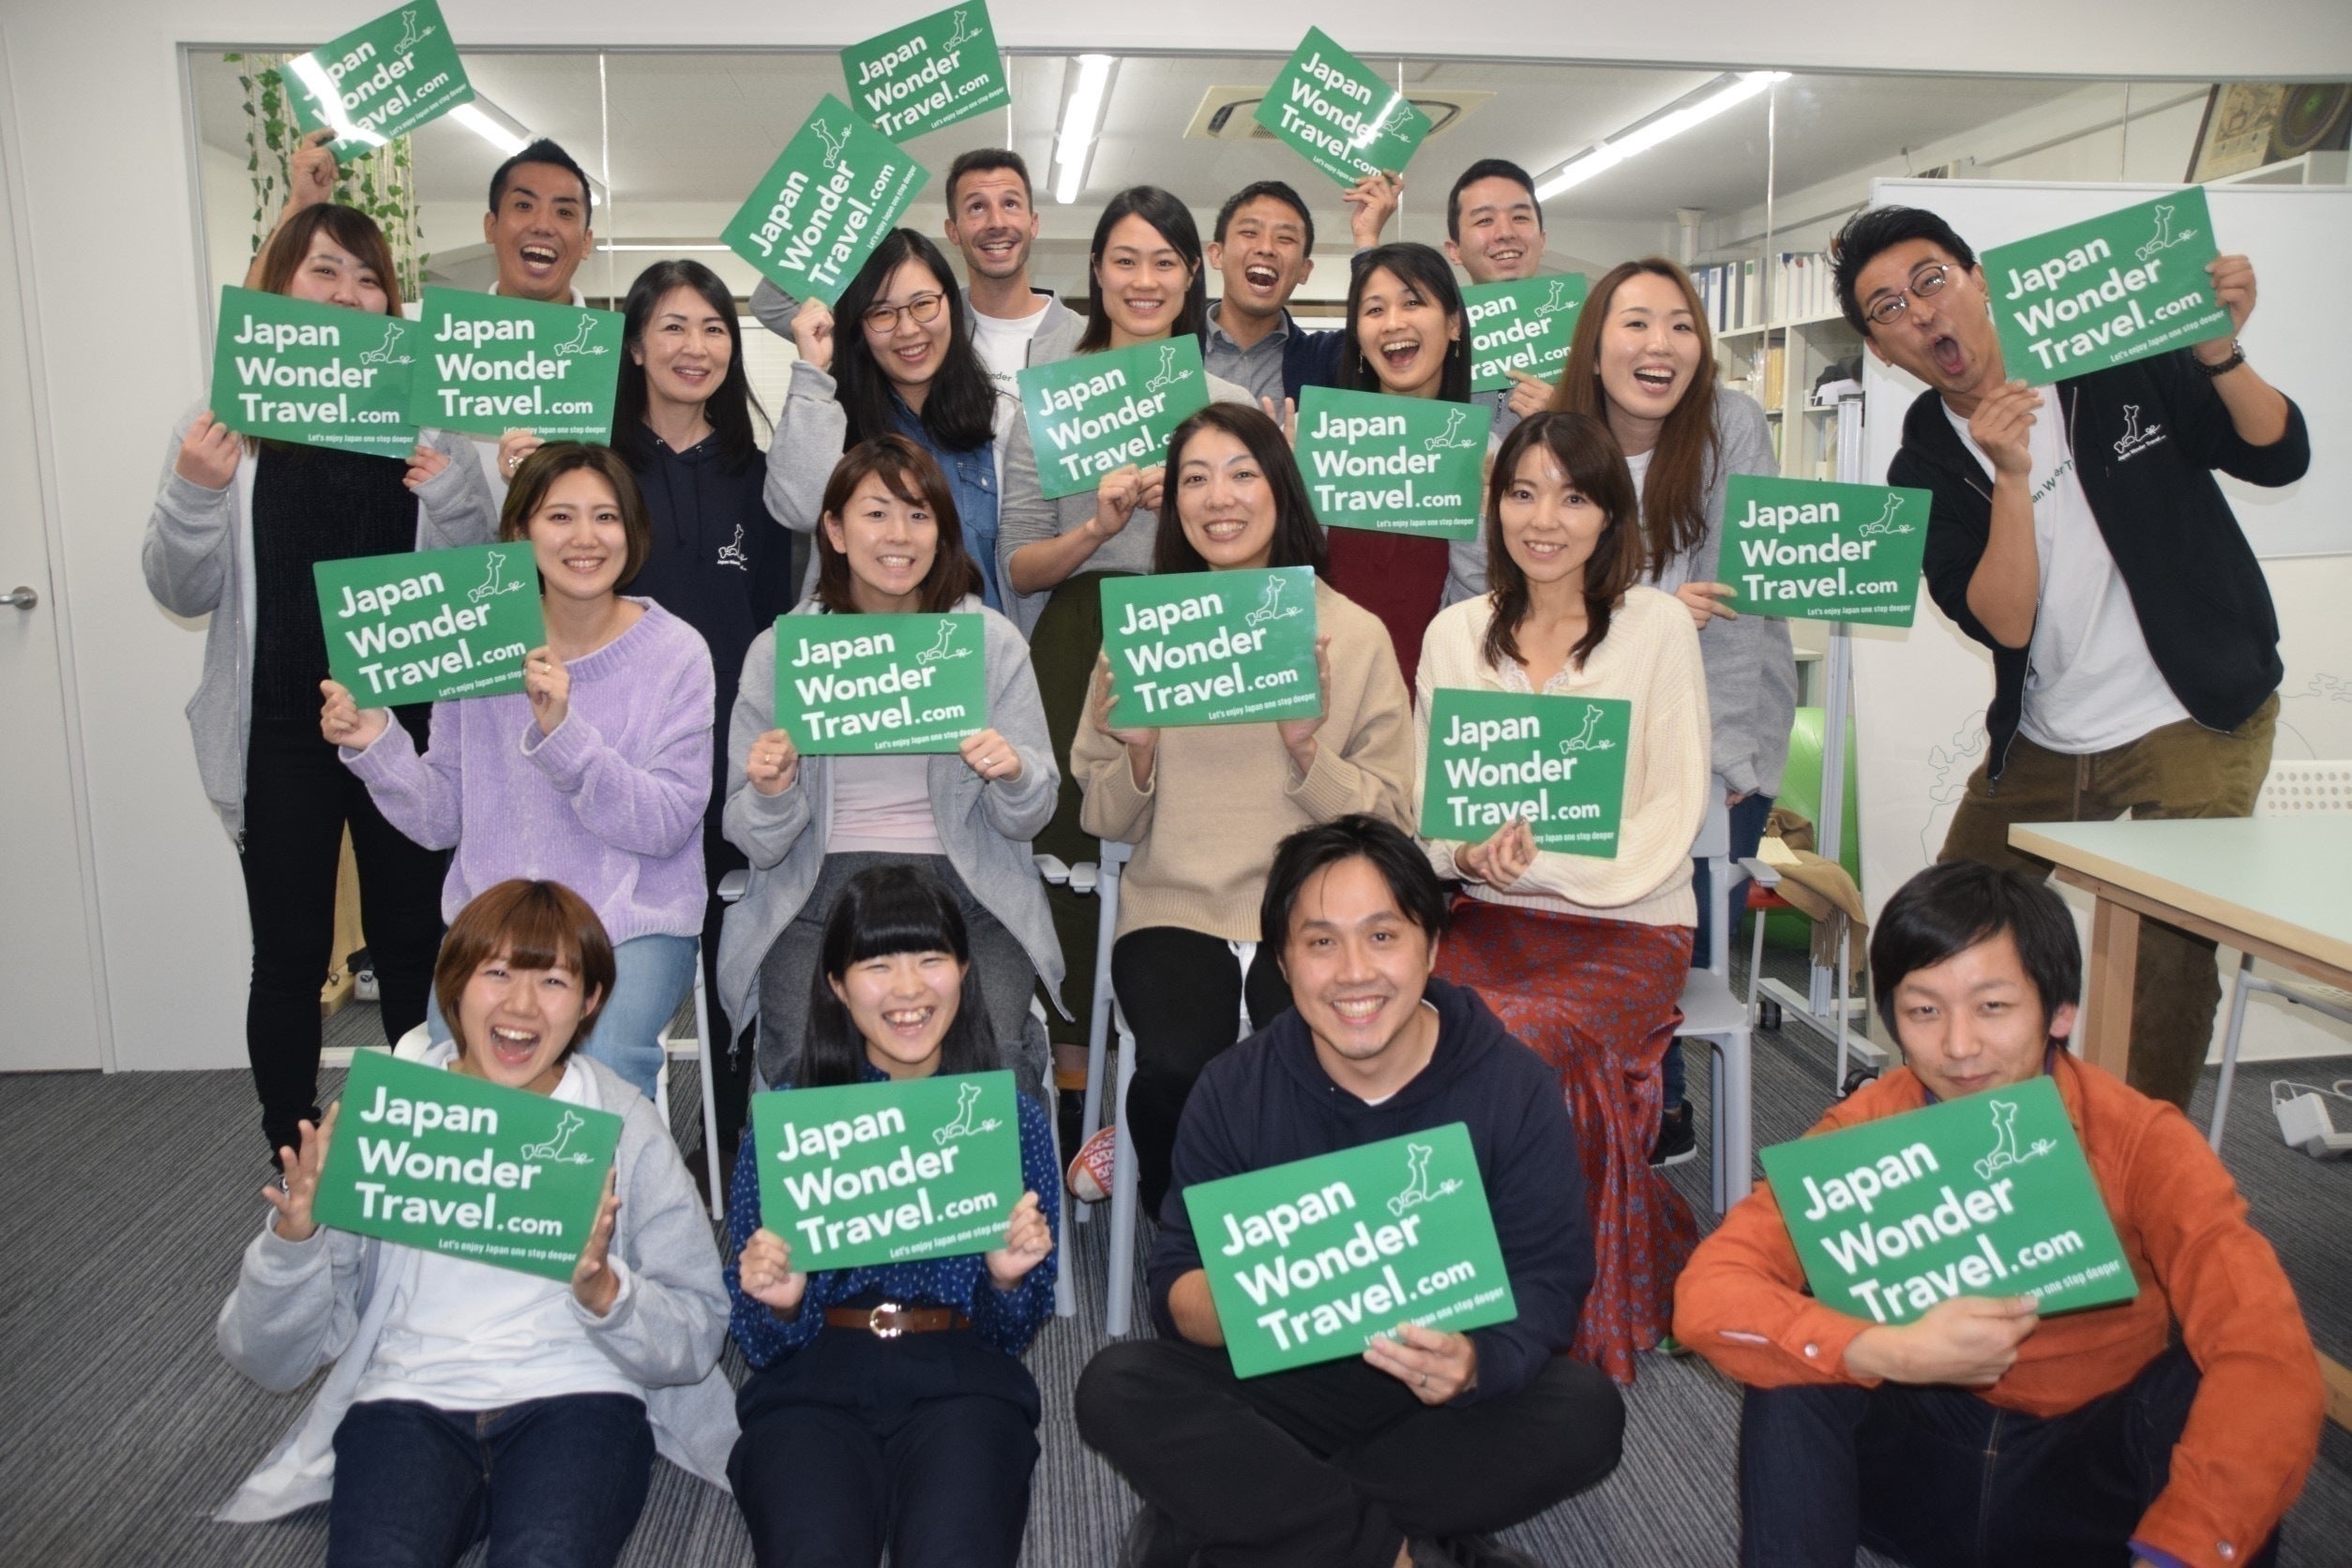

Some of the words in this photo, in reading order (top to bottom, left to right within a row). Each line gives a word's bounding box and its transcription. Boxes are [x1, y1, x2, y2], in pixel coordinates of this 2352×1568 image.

[302, 41, 376, 98] pan
[858, 36, 927, 84] Japan
[864, 50, 960, 112] Wonder
[1301, 52, 1371, 105] Japan
[326, 71, 448, 149] avel.com
[875, 72, 989, 136] Travel.com
[1280, 103, 1381, 179] Travel.com
[749, 171, 808, 256] Japan
[777, 159, 854, 270] Wonder
[807, 163, 895, 285] Travel.com
[2006, 238, 2111, 299] Japan
[1466, 295, 1517, 328] pan
[2013, 259, 2161, 336] Wonder
[234, 314, 339, 353] Japan
[434, 312, 535, 348] Japan
[1472, 317, 1552, 351] onder
[2028, 292, 2202, 369] Travel.com
[2110, 350, 2128, 361] Let's
[2129, 342, 2148, 354] enjoy
[2148, 333, 2168, 346] Japan
[2168, 327, 2182, 338] one
[2182, 321, 2199, 332] step
[2199, 309, 2223, 324] deeper
[234, 355, 377, 388] Wonder
[435, 350, 571, 381] Wonder
[1470, 342, 1572, 381] ravel.co
[237, 392, 400, 423] Travel.com
[437, 384, 593, 416] Travel.com
[1039, 368, 1126, 416] Japan
[1047, 391, 1166, 450] Wonder
[1311, 410, 1406, 445] Japan
[1059, 425, 1176, 481] Travel.c
[1312, 445, 1440, 477] Wonder
[1314, 479, 1461, 511] Travel.com
[1739, 499, 1839, 534] Japan
[1410, 519, 1426, 527] Japan
[1740, 533, 1877, 567] Wonder
[338, 571, 445, 617] Japan
[1742, 566, 1897, 601] Travel.com
[345, 603, 490, 658] Wonder
[1120, 594, 1223, 635] Japan
[1842, 606, 1860, 614] Japan
[358, 638, 524, 693] Travel.com
[792, 633, 895, 669] Japan
[1124, 626, 1266, 676] Wonder
[438, 686, 455, 696] Let's
[455, 682, 473, 691] enjoy
[474, 676, 492, 686] Japan
[505, 669, 520, 678] step
[795, 662, 935, 705] Wonder
[1134, 661, 1298, 712] Travel.com
[1208, 710, 1225, 719] Let's
[1226, 707, 1244, 716] enjoy
[1244, 702, 1263, 712] Japan
[1277, 697, 1292, 705] step
[1293, 692, 1316, 702] deeper
[802, 696, 964, 740] Travel.com
[874, 740, 891, 748] Let's
[911, 734, 929, 743] Japan
[1443, 714, 1540, 751] Japan
[1444, 749, 1576, 789] Wonder
[1447, 788, 1600, 826] Travel.com
[1545, 833, 1563, 842] Japan
[1576, 831, 1591, 840] step
[1592, 830, 1614, 839] deeper
[360, 1086, 498, 1138] Japan
[776, 1108, 905, 1161] Japan
[357, 1137, 541, 1189] Wonder
[783, 1145, 957, 1211] Wonder
[1802, 1143, 1938, 1220] Japan
[354, 1182, 562, 1236] Travel.com
[796, 1187, 996, 1254] Travel.com
[1223, 1182, 1355, 1255] Japan
[1821, 1178, 2013, 1274] Wonder
[438, 1238, 459, 1249] Let's
[460, 1243, 484, 1253] enjoy
[485, 1244, 509, 1255] Japan
[510, 1247, 525, 1256] one
[527, 1248, 546, 1259] step
[548, 1250, 576, 1261] deeper
[889, 1245, 910, 1258] Let's
[911, 1241, 932, 1252] enjoy
[934, 1234, 956, 1246] Japan
[957, 1230, 972, 1240] one
[972, 1226, 990, 1236] step
[1234, 1214, 1420, 1305] Wonder
[1849, 1230, 2084, 1320] Travel.com
[2043, 1281, 2062, 1293] one
[2062, 1274, 2086, 1288] step
[2086, 1260, 2119, 1279] deeper
[1257, 1260, 1475, 1349] Travel.com
[1437, 1306, 1453, 1318] one
[1454, 1298, 1473, 1311] step
[1474, 1287, 1503, 1304] deeper
